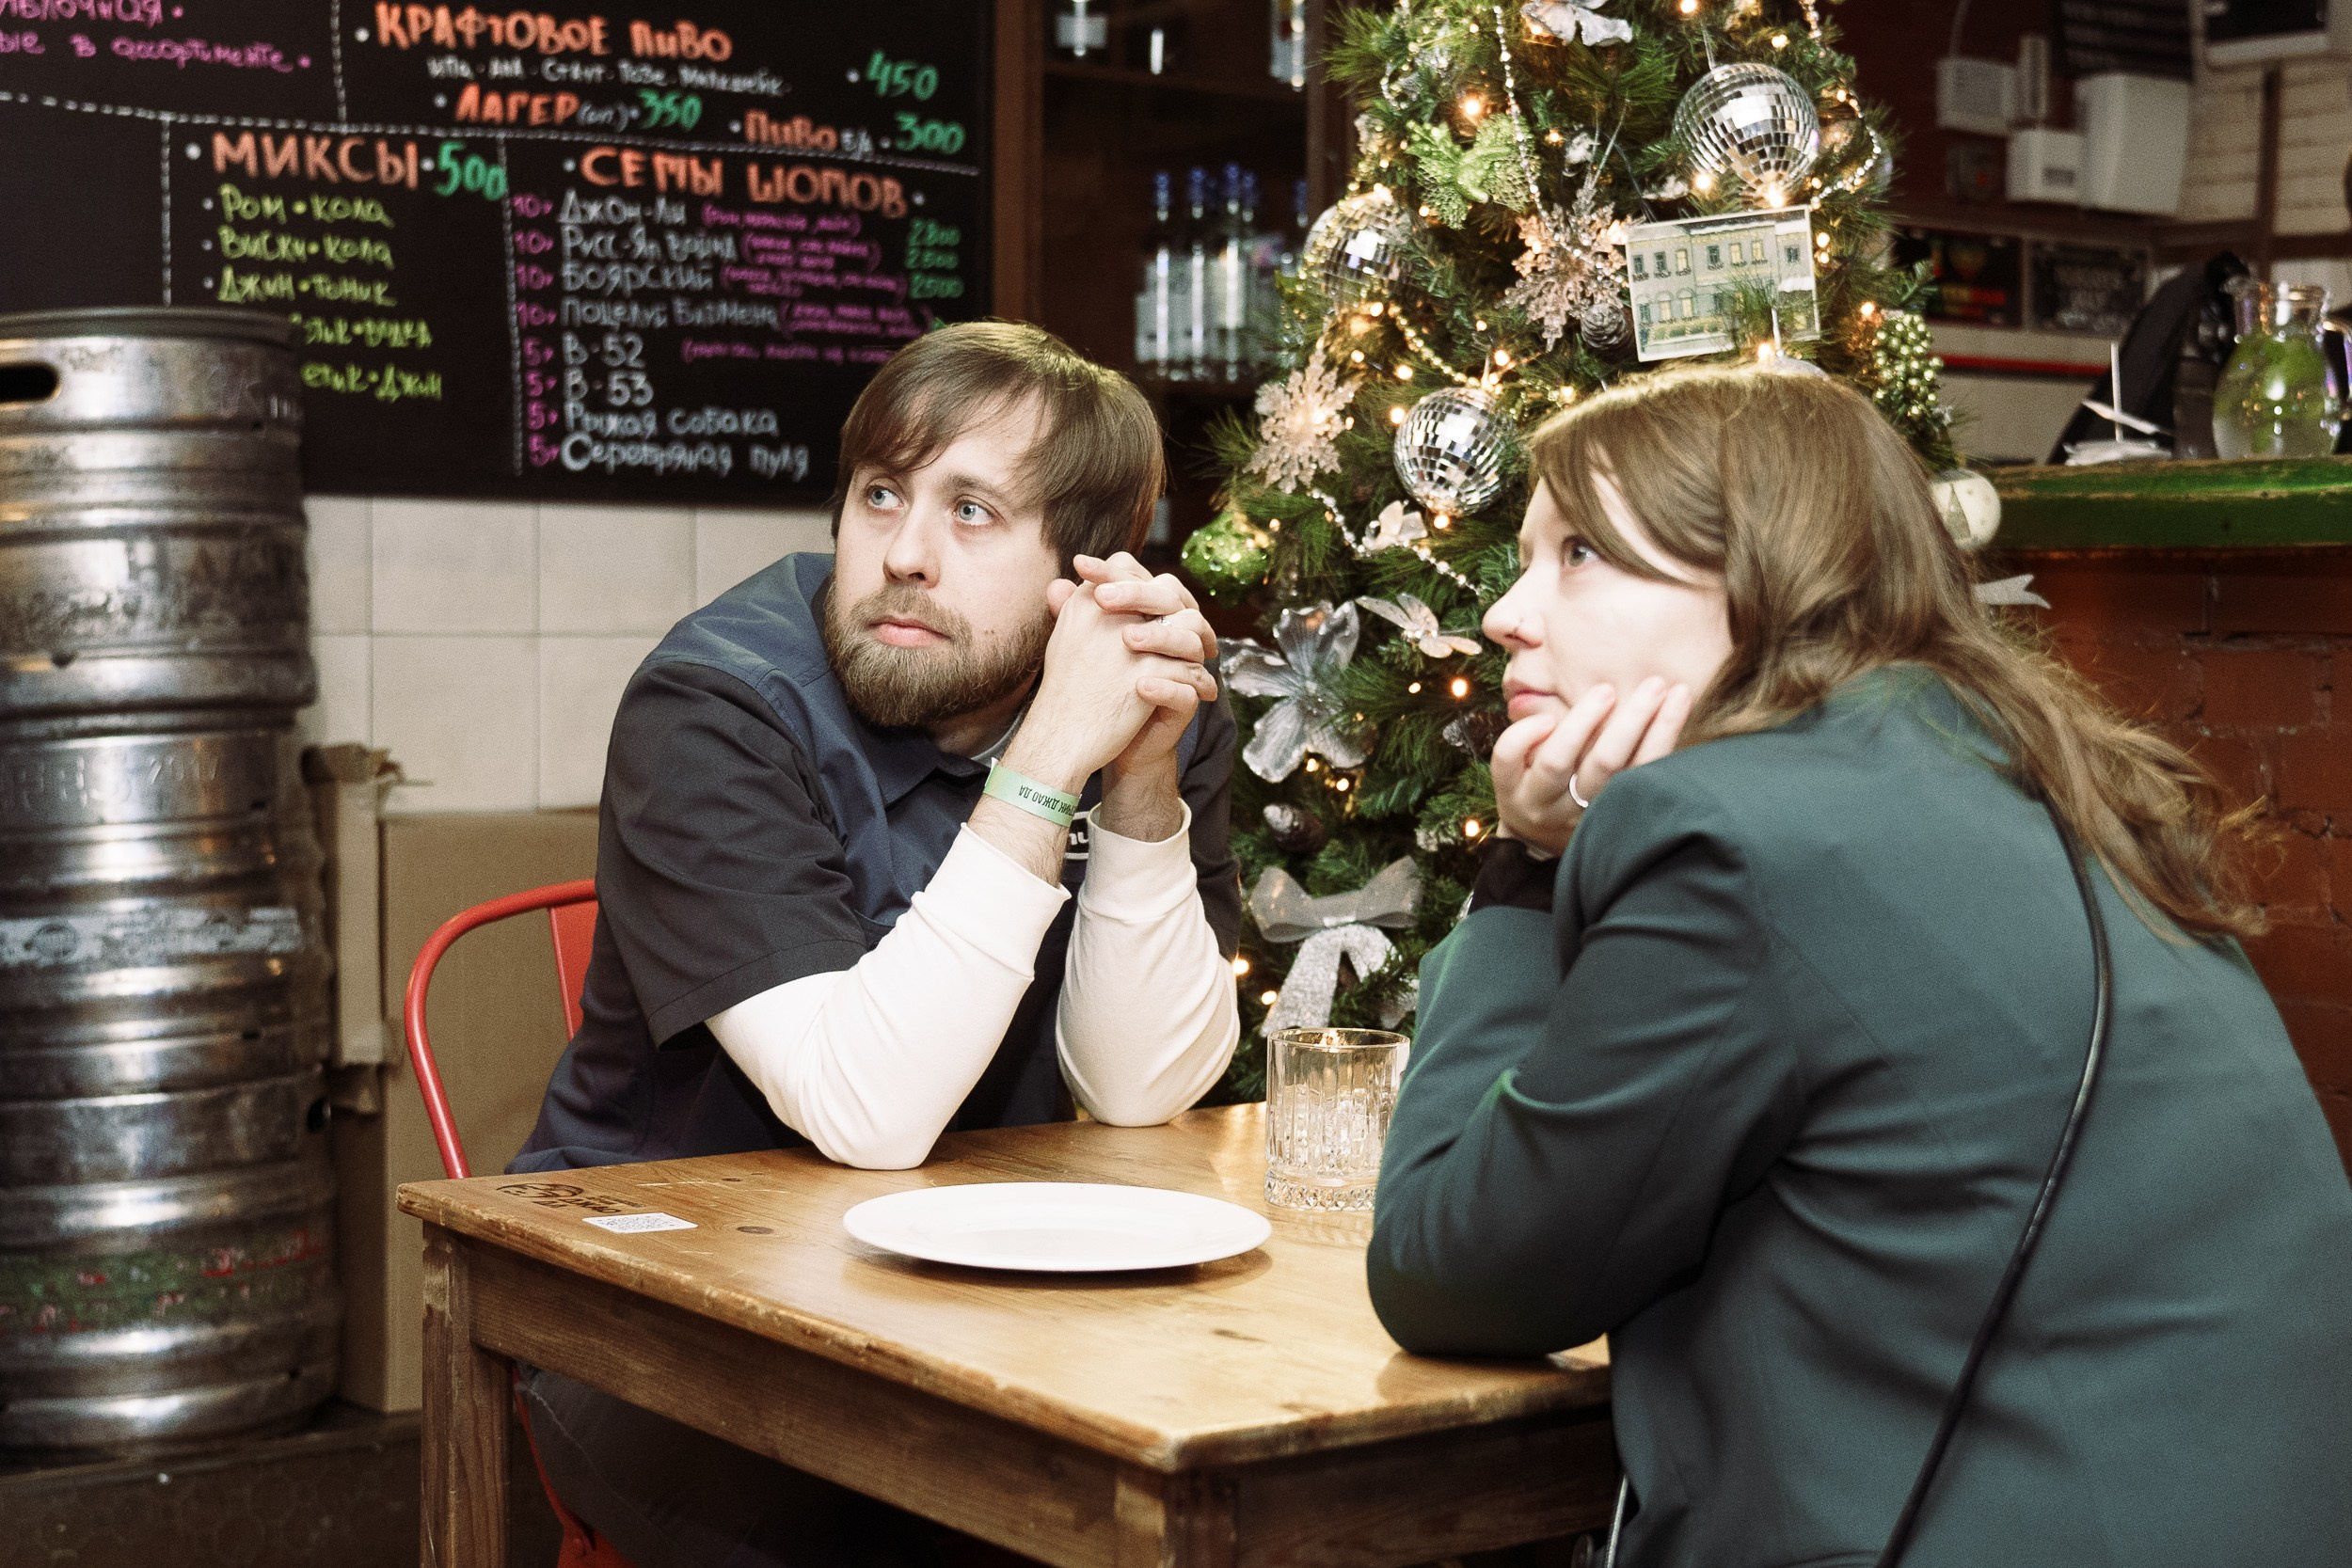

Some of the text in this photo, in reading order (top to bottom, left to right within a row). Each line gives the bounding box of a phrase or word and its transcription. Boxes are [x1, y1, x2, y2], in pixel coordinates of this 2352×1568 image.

[866, 50, 940, 98] 450
[637, 88, 704, 130] 350
[895, 111, 966, 154] 300
[212, 132, 508, 200] МИКСЫ 500
[218, 182, 287, 224] Ром
[217, 224, 307, 262] Виски
[217, 264, 295, 303] Джин
[603, 332, 645, 369] 52
[608, 370, 654, 405] 53
[1019, 784, 1032, 799] ДА
[1033, 792, 1060, 810] ДЖАО
